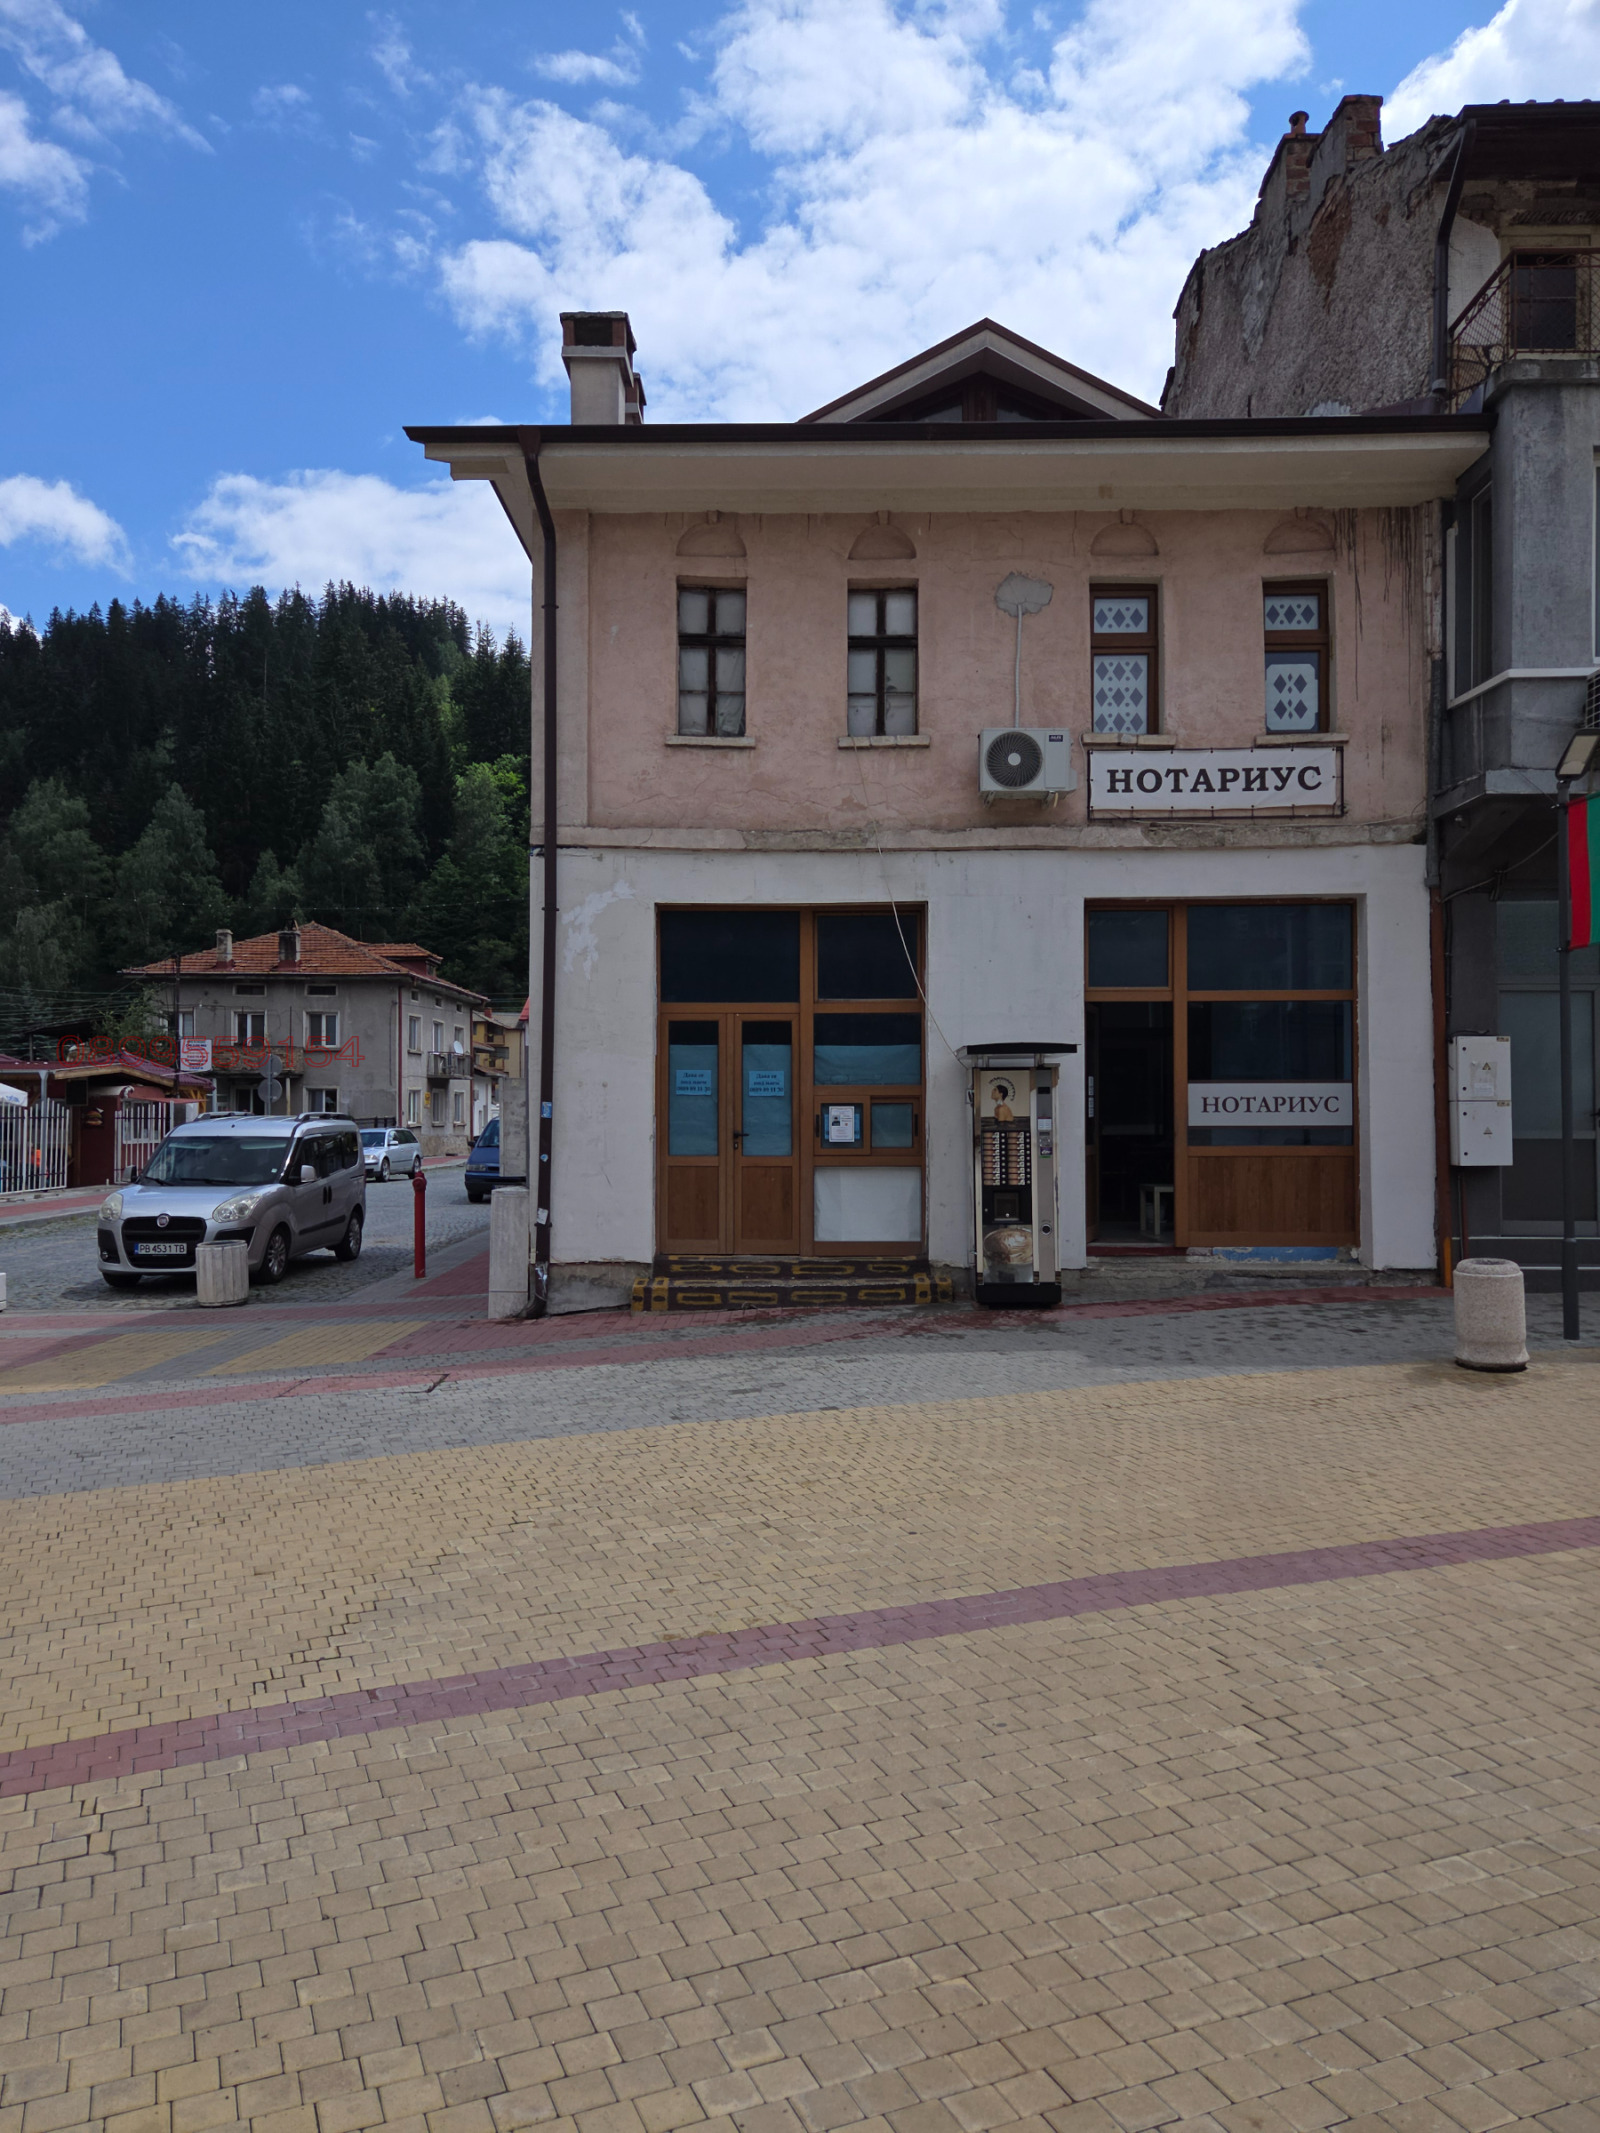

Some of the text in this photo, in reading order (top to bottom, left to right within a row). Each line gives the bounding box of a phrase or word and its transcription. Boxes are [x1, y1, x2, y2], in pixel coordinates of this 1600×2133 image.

[1106, 765, 1322, 793] НОТАРИУС
[1201, 1096, 1339, 1113] НОТАРИУС
[140, 1244, 185, 1253] PB 4531 TB
